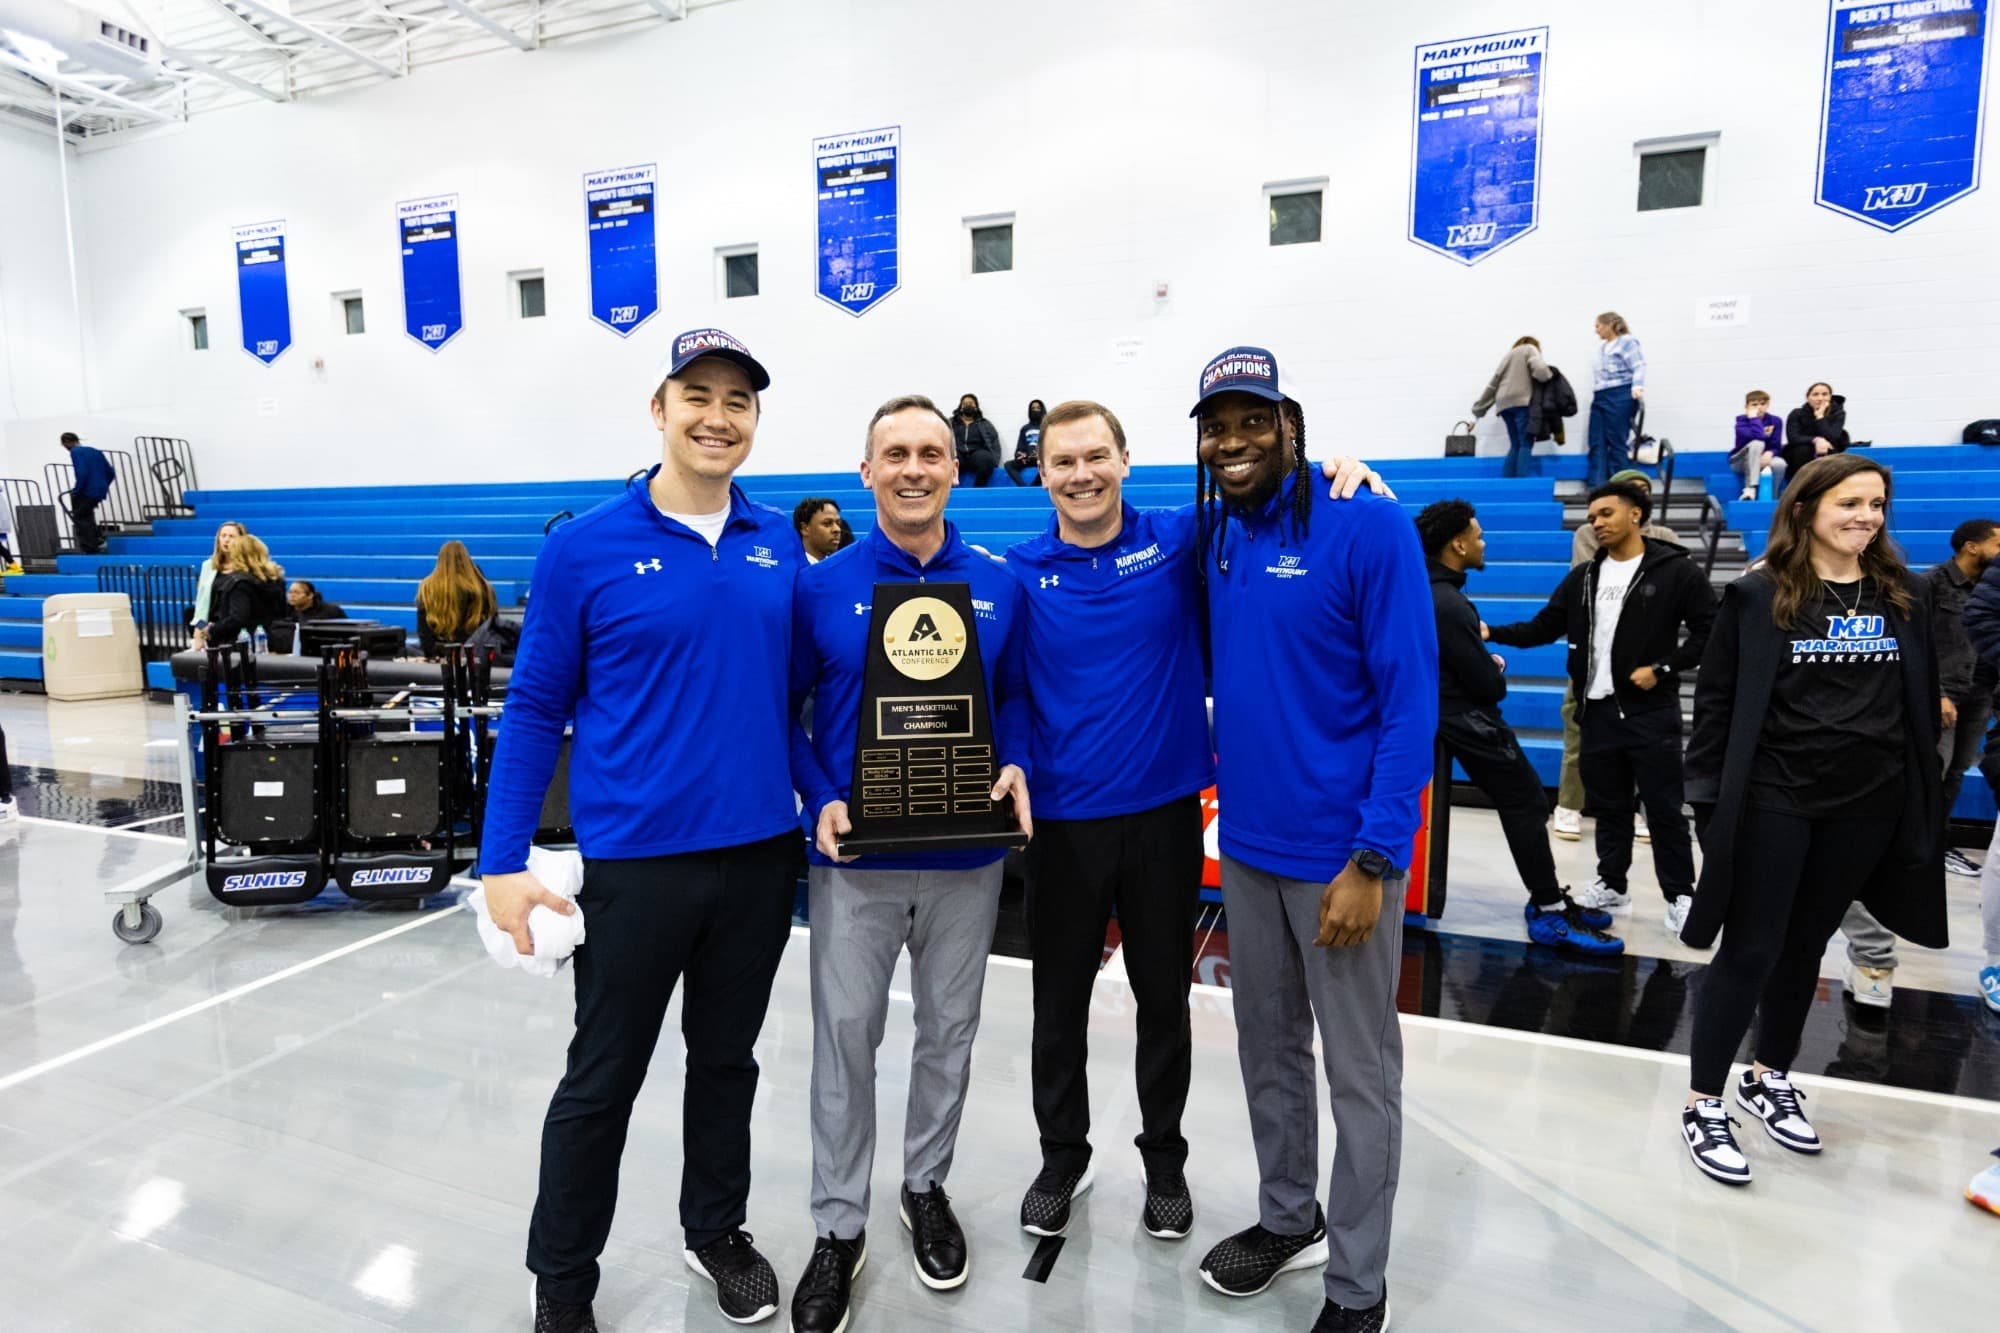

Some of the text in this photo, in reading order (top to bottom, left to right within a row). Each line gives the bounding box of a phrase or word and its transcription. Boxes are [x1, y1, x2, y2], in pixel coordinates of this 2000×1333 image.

[1423, 35, 1541, 62] MARYMOUNT
[818, 132, 894, 152] MARYMOUNT
[1202, 361, 1272, 391] CHAMPIONS
[1114, 542, 1161, 570] MARYMOUNT
[971, 598, 995, 613] MOUNT
[975, 610, 998, 621] TBALL
[892, 648, 960, 658] ATLANTIC EAST
[1790, 637, 1899, 654] MARYMOUN
[901, 657, 950, 665] CONFERENCE
[1792, 652, 1901, 664] BASKETBAL
[891, 703, 959, 713] MEN'S BASKETBALL
[903, 720, 948, 730] CHAMPION
[223, 871, 307, 892] SAINTS
[351, 867, 433, 887] SAINTS
